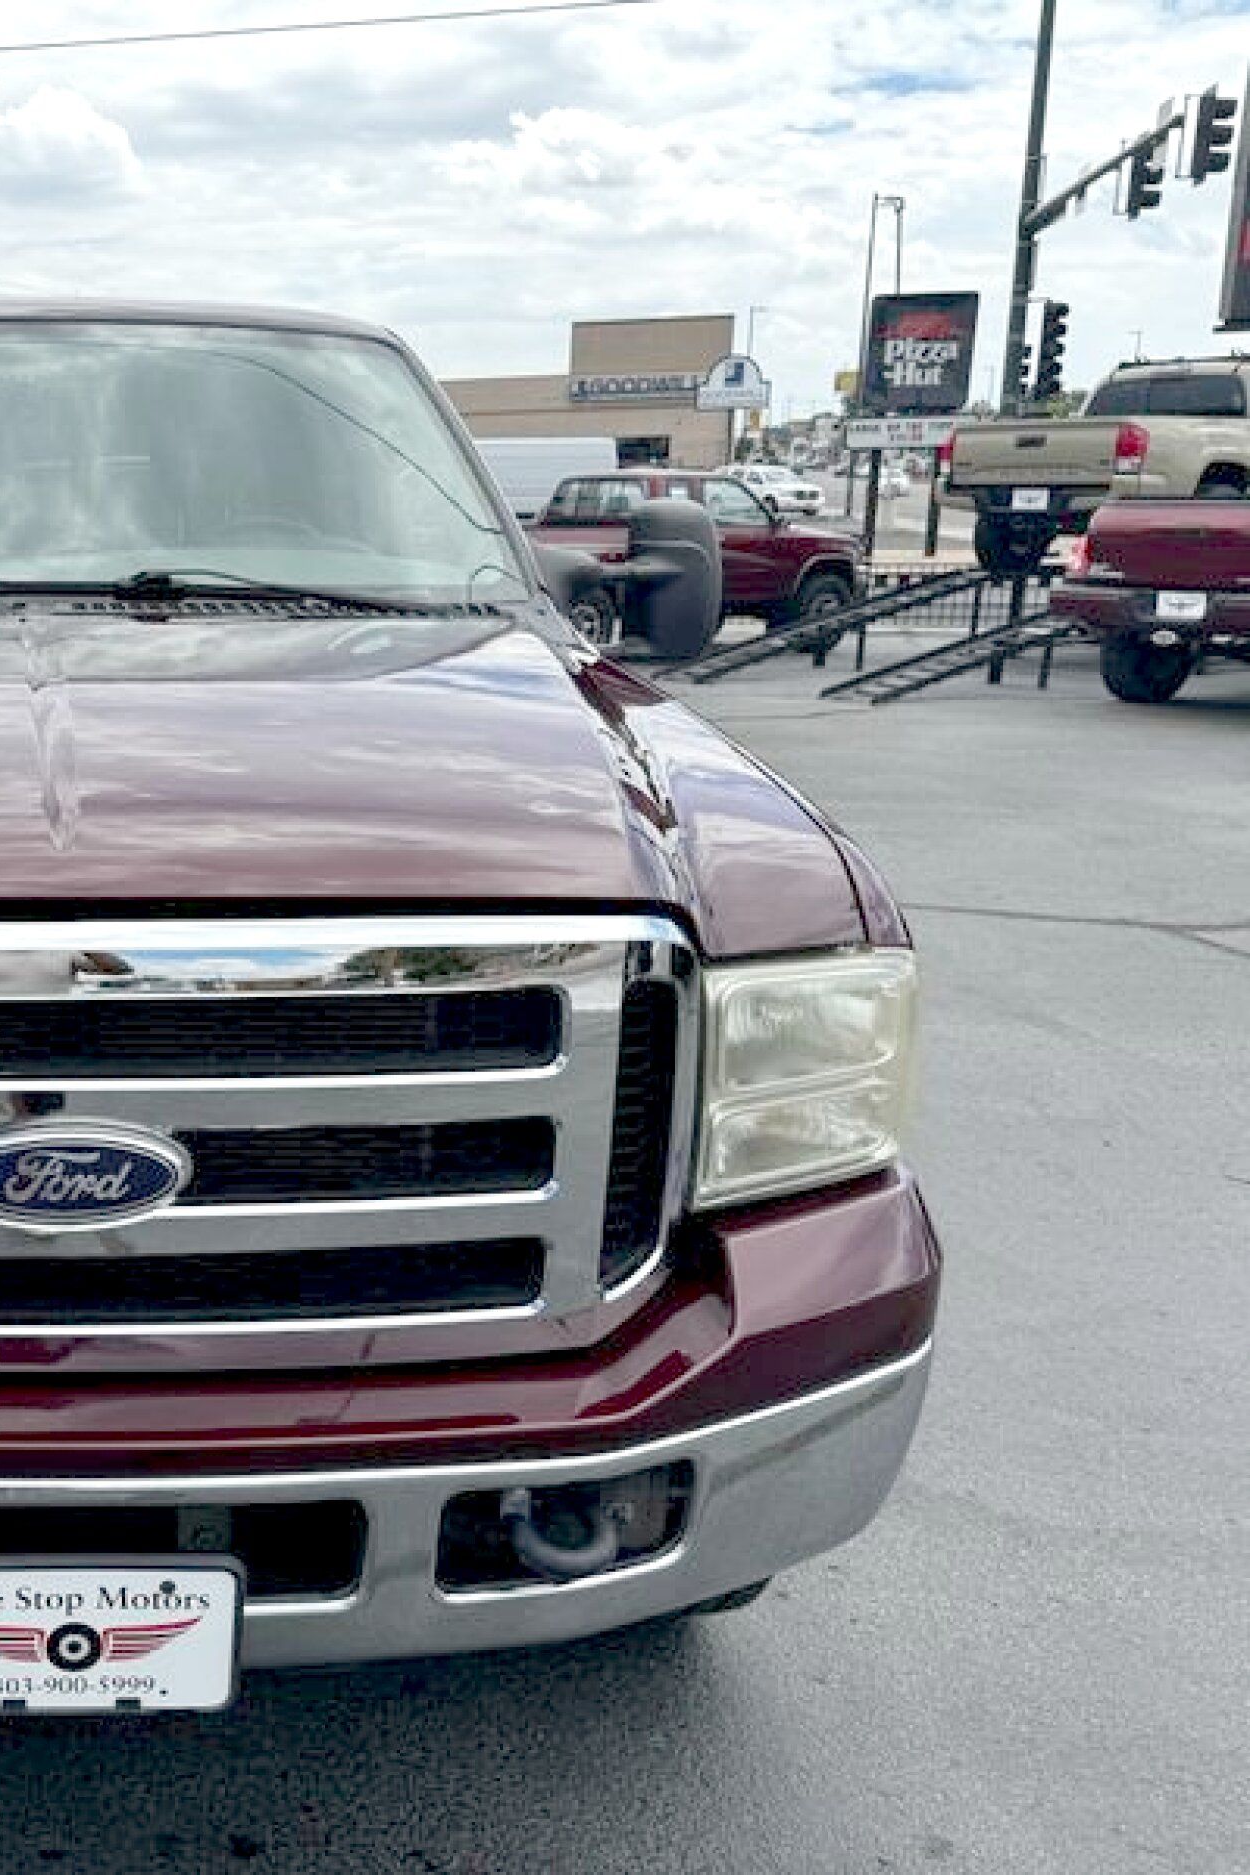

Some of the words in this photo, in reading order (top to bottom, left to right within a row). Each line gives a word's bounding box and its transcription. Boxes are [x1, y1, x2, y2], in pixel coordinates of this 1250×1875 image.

[883, 336, 958, 366] Pizza
[882, 361, 944, 386] Hut
[5, 1152, 132, 1203] Ford
[14, 1586, 83, 1616] Stop
[96, 1586, 211, 1611] Motors
